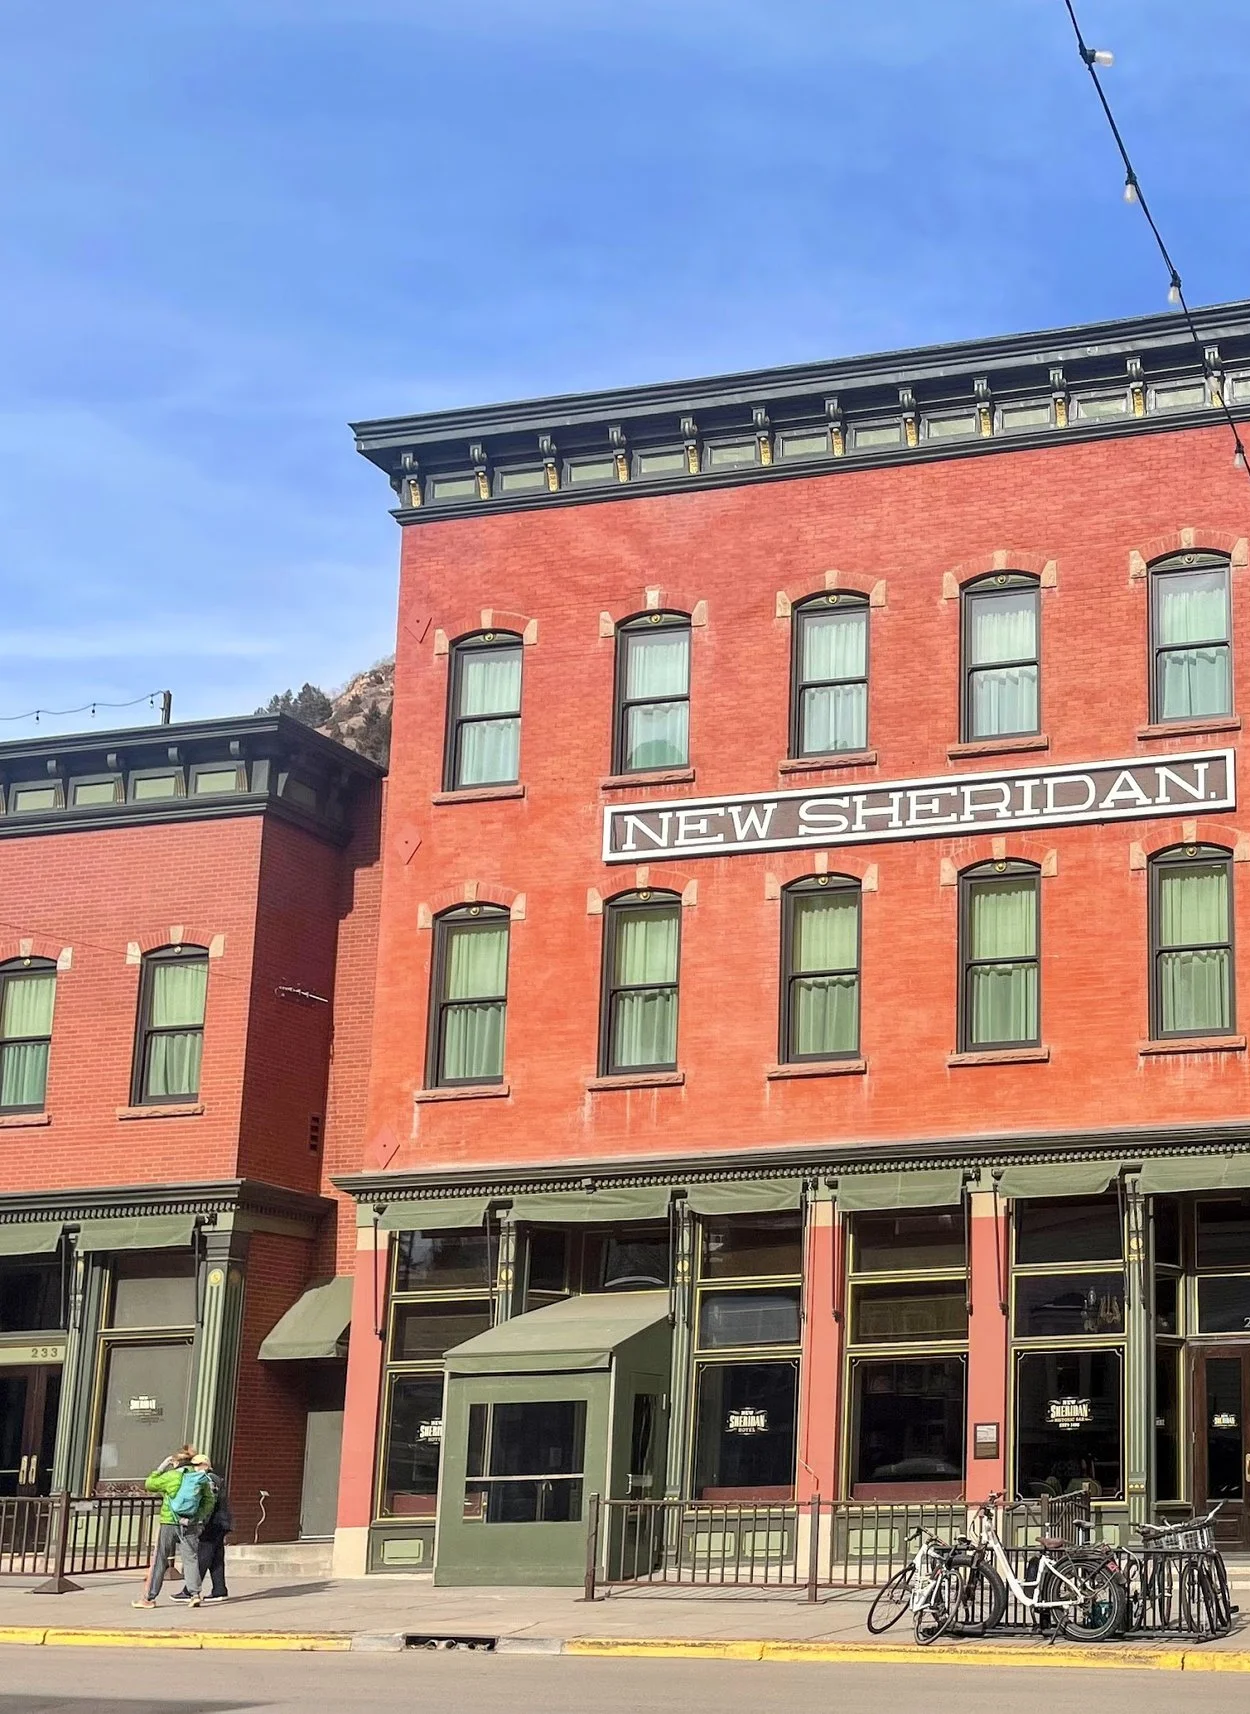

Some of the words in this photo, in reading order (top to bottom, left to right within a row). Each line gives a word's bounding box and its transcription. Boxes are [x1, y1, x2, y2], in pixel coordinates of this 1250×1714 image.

[622, 802, 778, 850] NEW
[798, 762, 1216, 837] SHERIDAN.
[31, 1347, 58, 1358] 233
[1050, 1403, 1088, 1419] SHERIDAN
[729, 1414, 766, 1429] SHERIDAN
